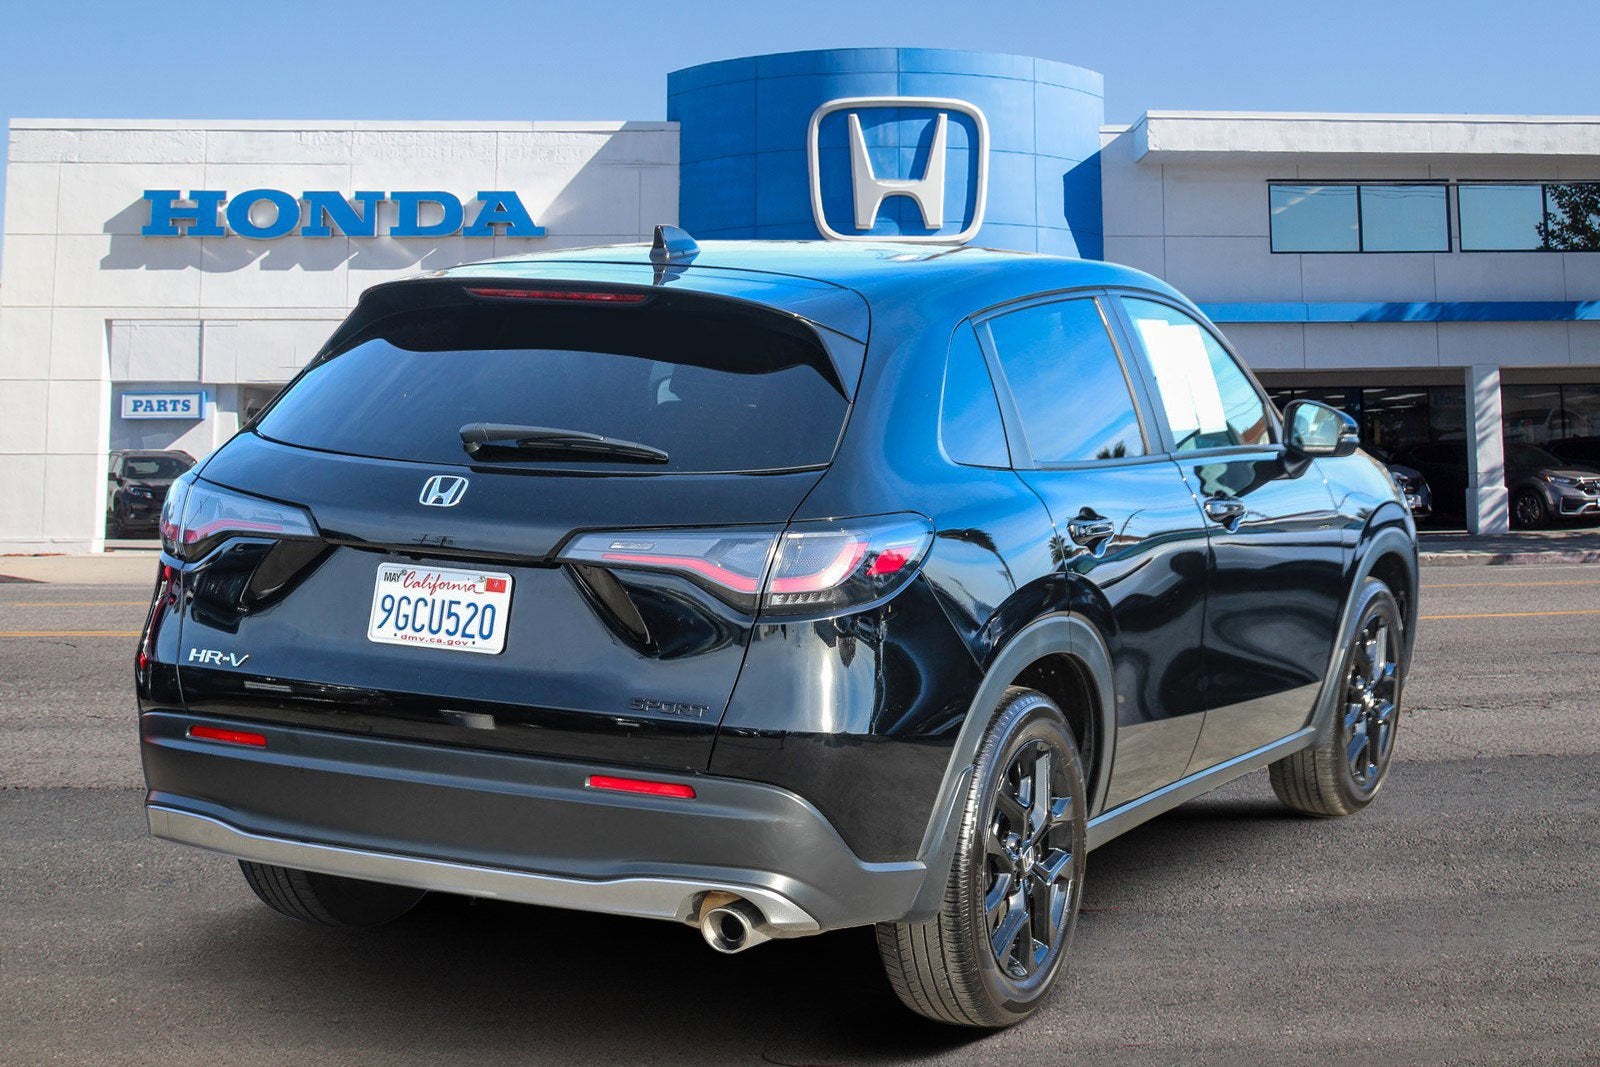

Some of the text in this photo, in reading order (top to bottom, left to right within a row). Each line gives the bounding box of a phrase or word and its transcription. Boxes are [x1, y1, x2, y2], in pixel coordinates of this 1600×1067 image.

[141, 188, 547, 239] HONDA
[131, 399, 191, 412] PARTS
[383, 571, 401, 583] MAY
[403, 570, 484, 596] California
[377, 594, 497, 640] 9GCU520
[401, 634, 469, 646] dmv.ca.gov
[188, 648, 250, 667] HR-V
